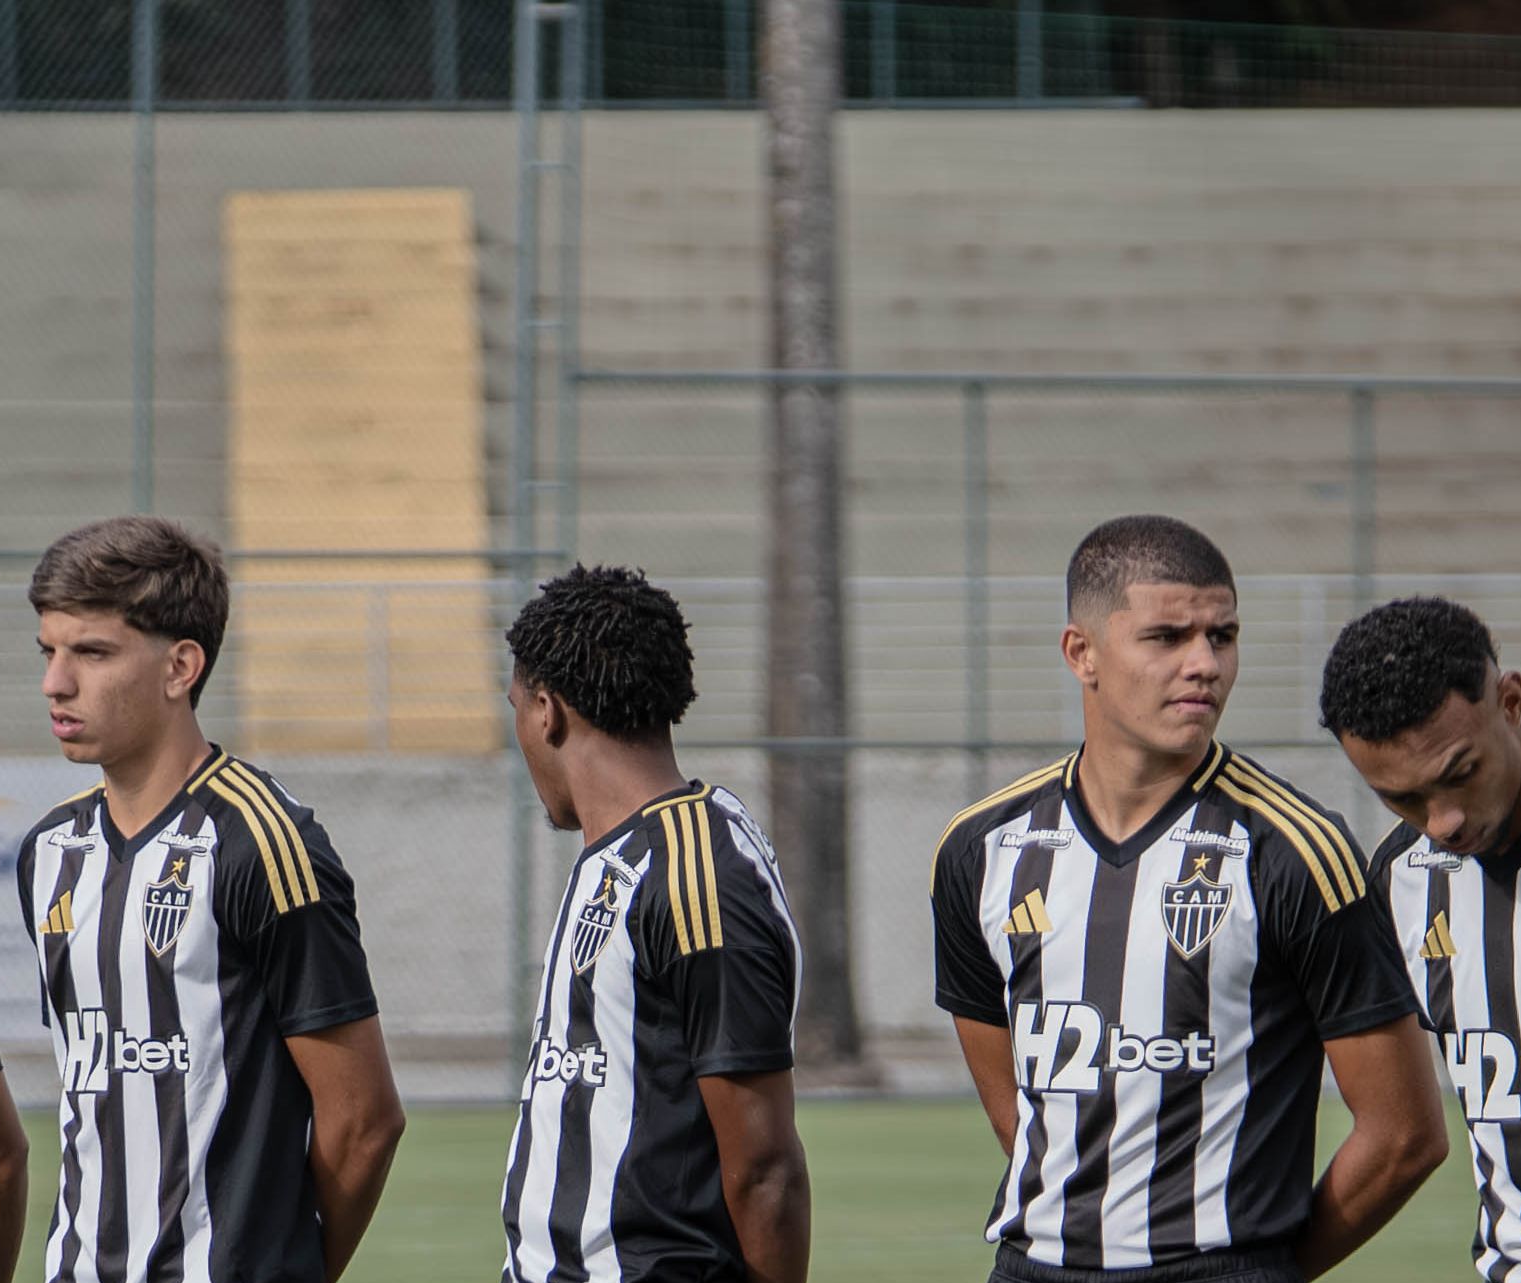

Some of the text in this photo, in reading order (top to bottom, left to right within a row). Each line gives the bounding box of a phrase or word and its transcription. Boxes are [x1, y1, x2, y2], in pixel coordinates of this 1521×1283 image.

[151, 890, 187, 906] CAM
[1172, 889, 1223, 905] CAM
[584, 907, 613, 926] CAM
